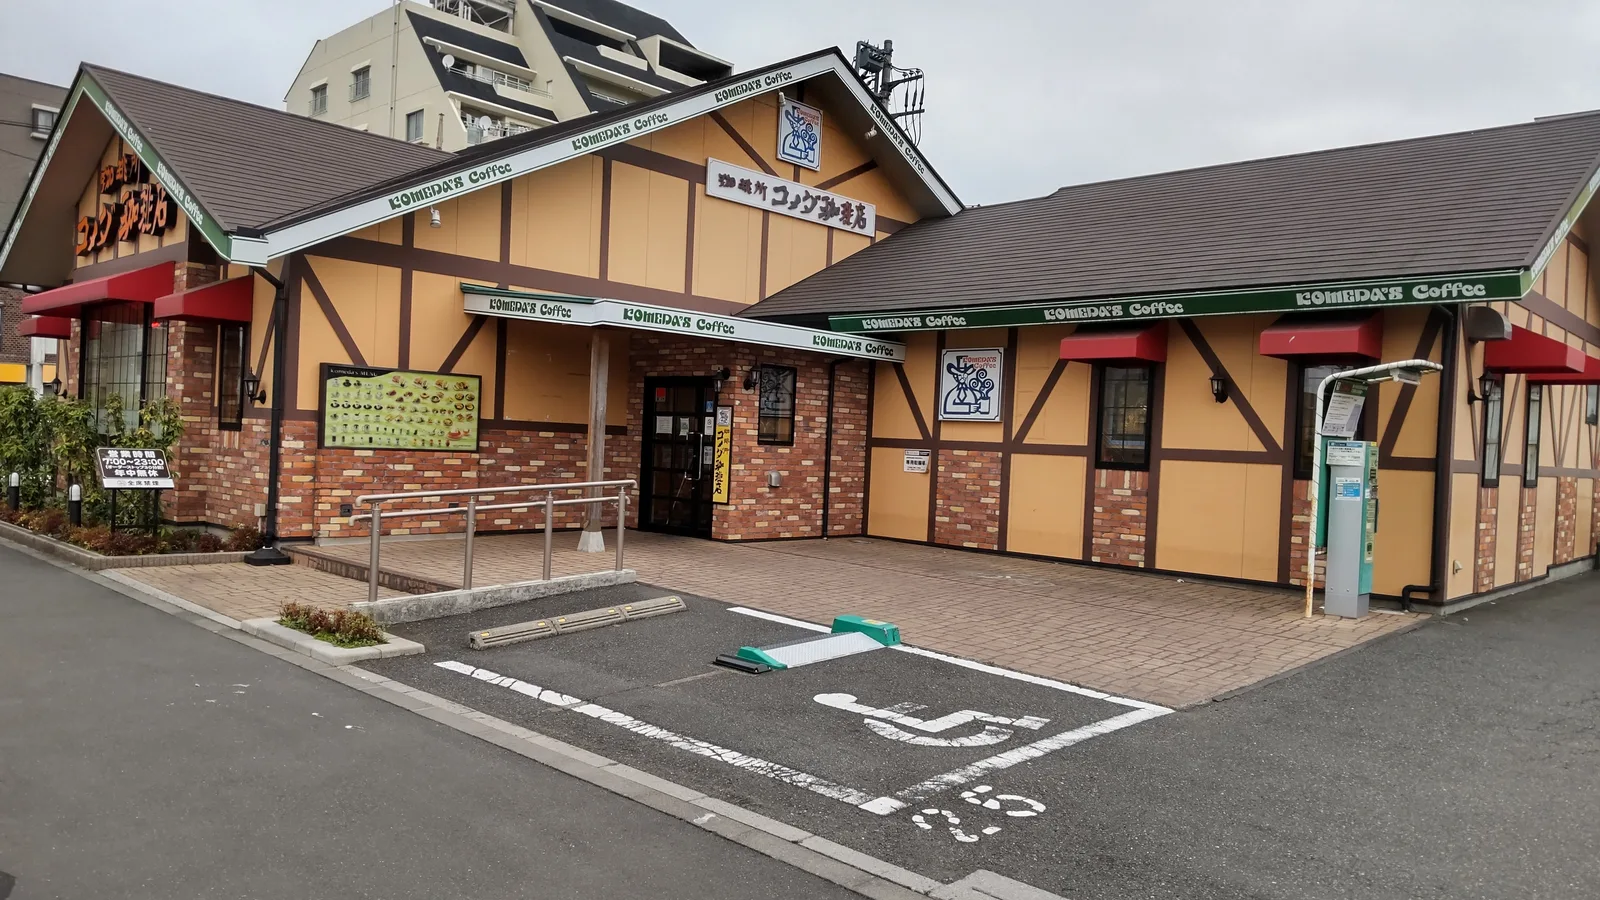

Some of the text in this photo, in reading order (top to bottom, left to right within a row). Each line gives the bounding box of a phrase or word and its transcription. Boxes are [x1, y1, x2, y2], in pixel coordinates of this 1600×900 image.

[714, 70, 793, 104] KOMEDA'S Coffee
[127, 127, 144, 152] Coffee
[571, 112, 669, 152] KOMEDA'S Coffee
[870, 102, 926, 175] KOMEDA'S Coffee
[157, 161, 204, 225] KOMEDA'S Coffee
[389, 162, 513, 211] KOMEDA'S Coffee
[771, 185, 867, 230] コメダ珈琲店
[1295, 282, 1486, 306] KOMEDA'S Coffee
[489, 298, 572, 319] KOMEDA'S Coffee
[1044, 301, 1184, 321] KOMEDA'S Coffee
[623, 307, 736, 336] KOMEDA'S Coffee
[862, 314, 967, 330] KOMEDA'S Coffee
[812, 334, 894, 358] KOMEDA'S Coffee
[107, 450, 155, 458] 営業時間
[114, 469, 159, 477] 年中無休
